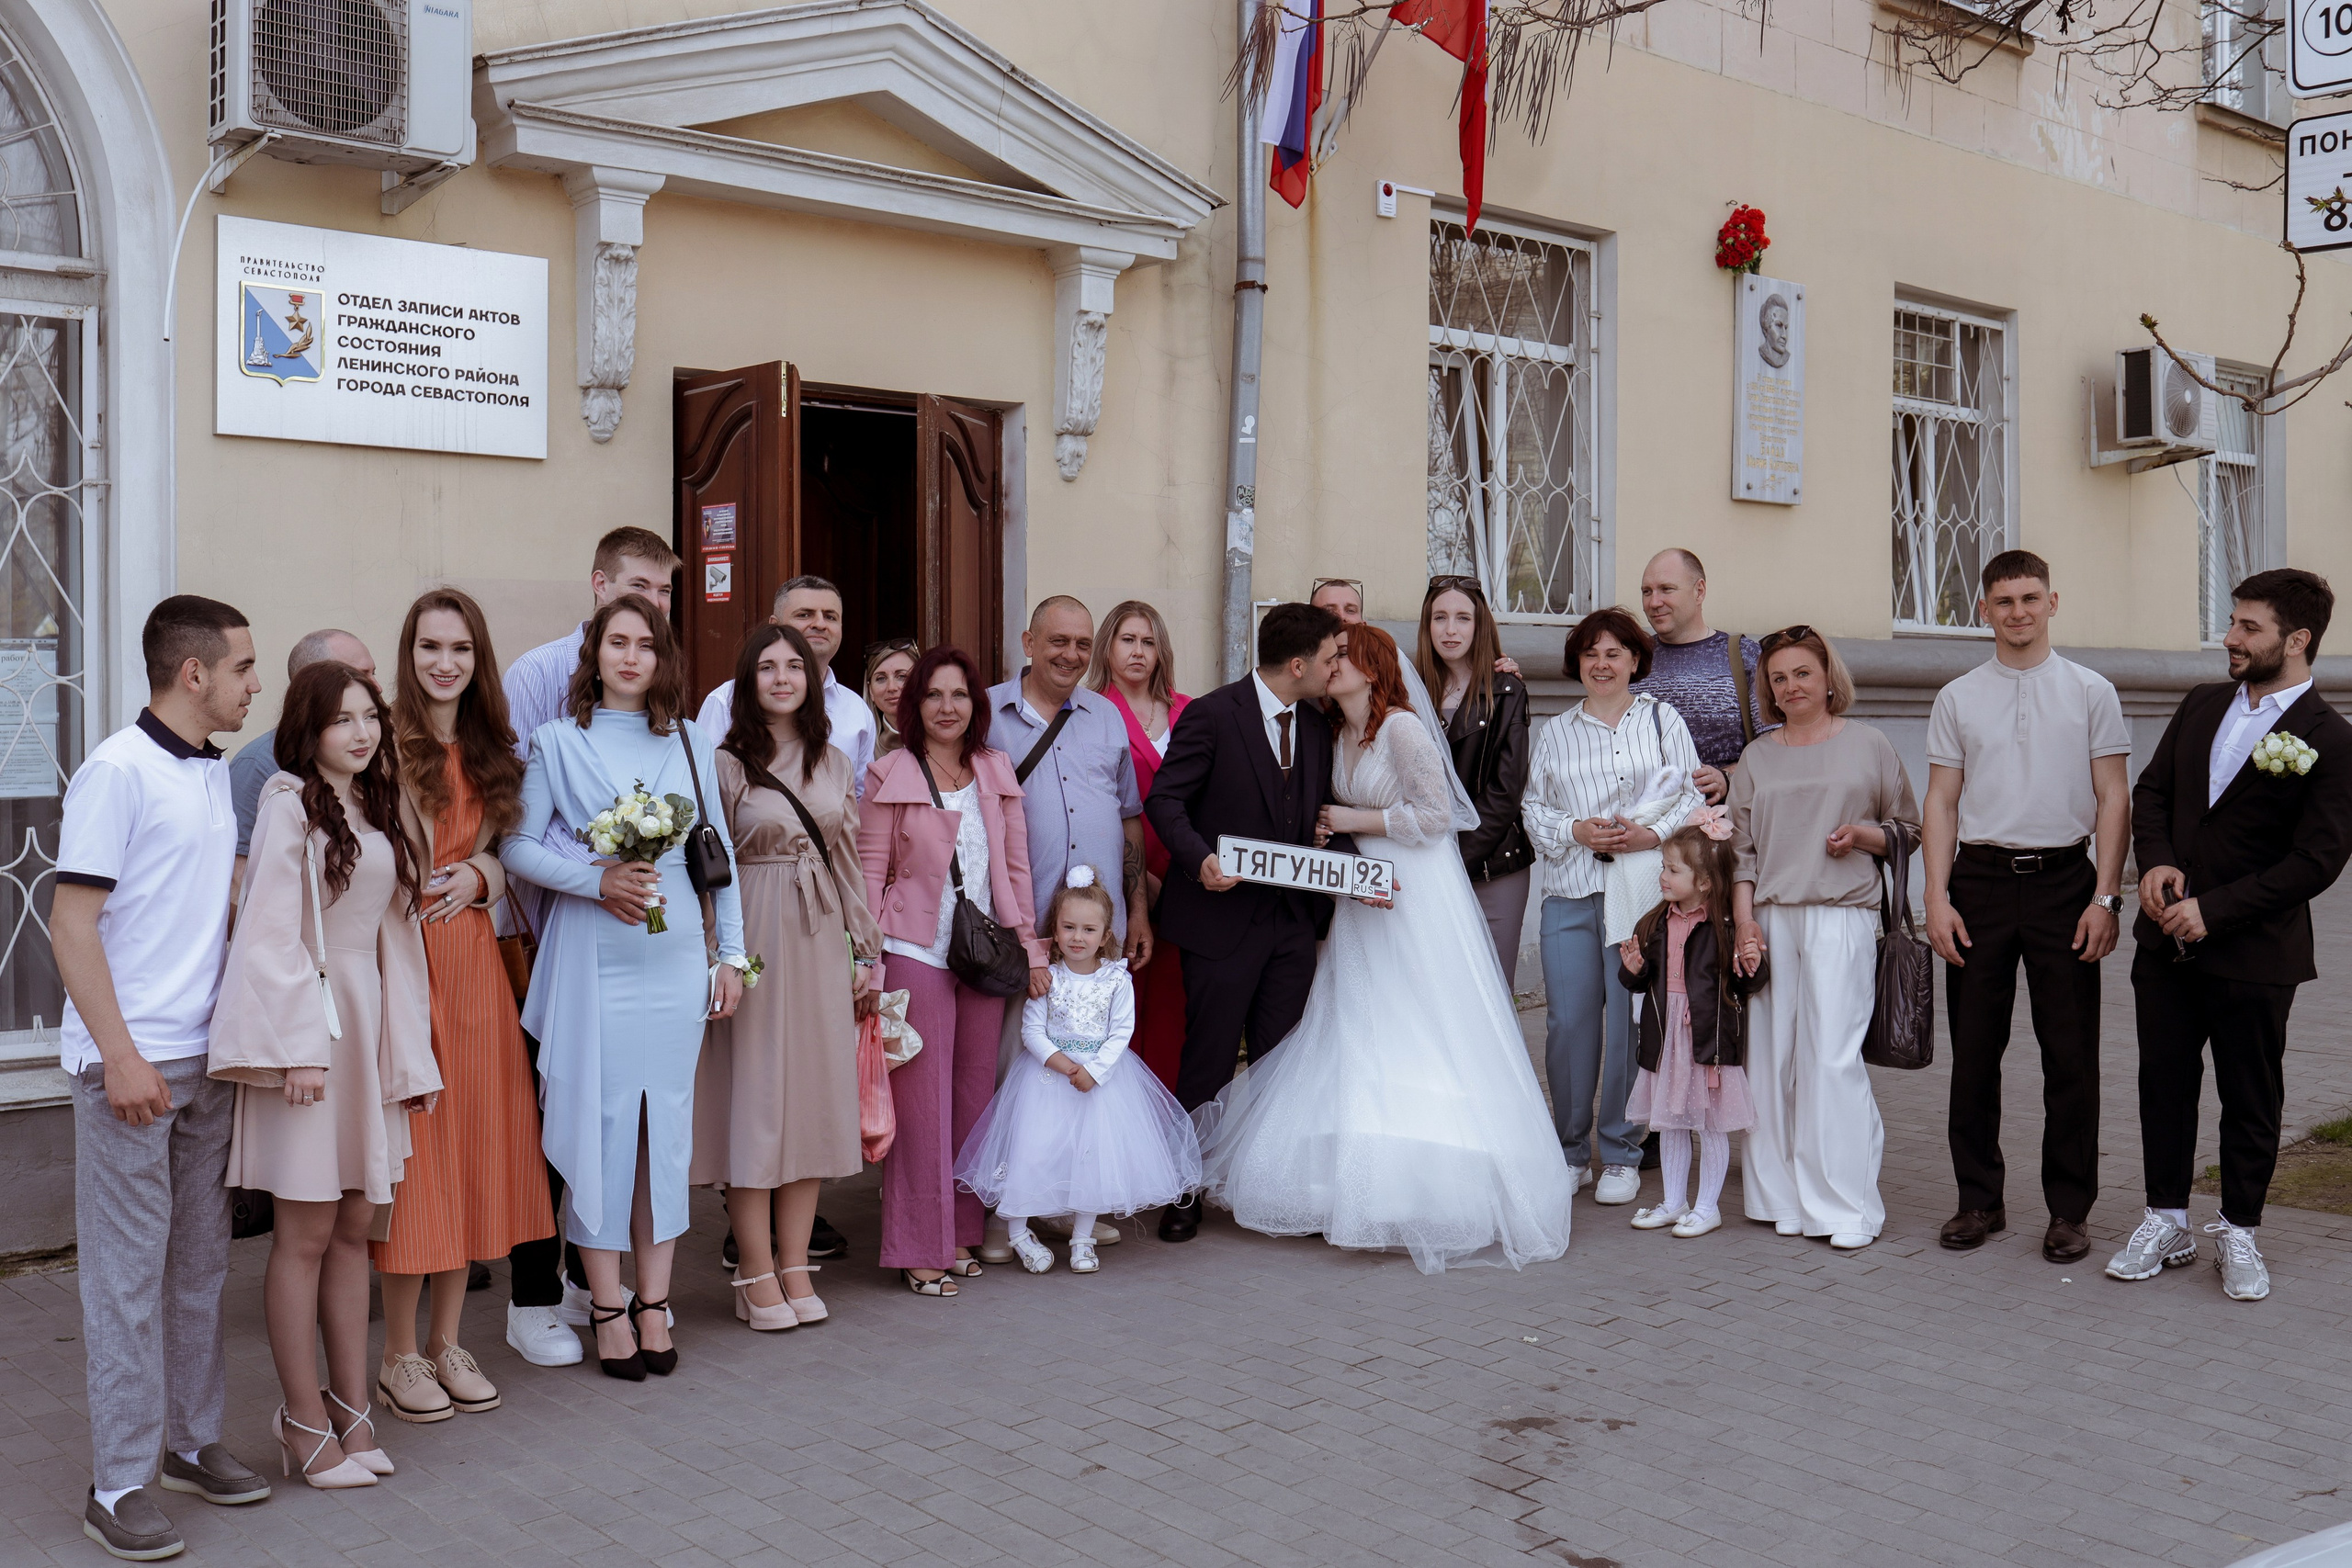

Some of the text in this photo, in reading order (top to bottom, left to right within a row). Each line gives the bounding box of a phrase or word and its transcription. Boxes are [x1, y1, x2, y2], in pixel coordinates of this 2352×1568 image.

[424, 5, 458, 18] NIAGARA
[240, 255, 324, 273] ПРАВИТЕЛЬСТВО
[243, 266, 320, 282] СЕВАСТОПОЛЯ
[337, 293, 520, 325] ОТДЕЛ ЗАПИСИ АКТОВ
[337, 314, 475, 341] ГРАЖДАНСКОГО
[337, 335, 441, 357] СОСТОЯНИЯ
[336, 356, 519, 386] ЛЕНИНСКОГО РАЙОНА
[337, 378, 529, 408] ГОРОДА СЕВАСТОПОЛЯ
[1232, 847, 1383, 888] ТЯГУНЫ 92
[1353, 883, 1374, 895] RUS
